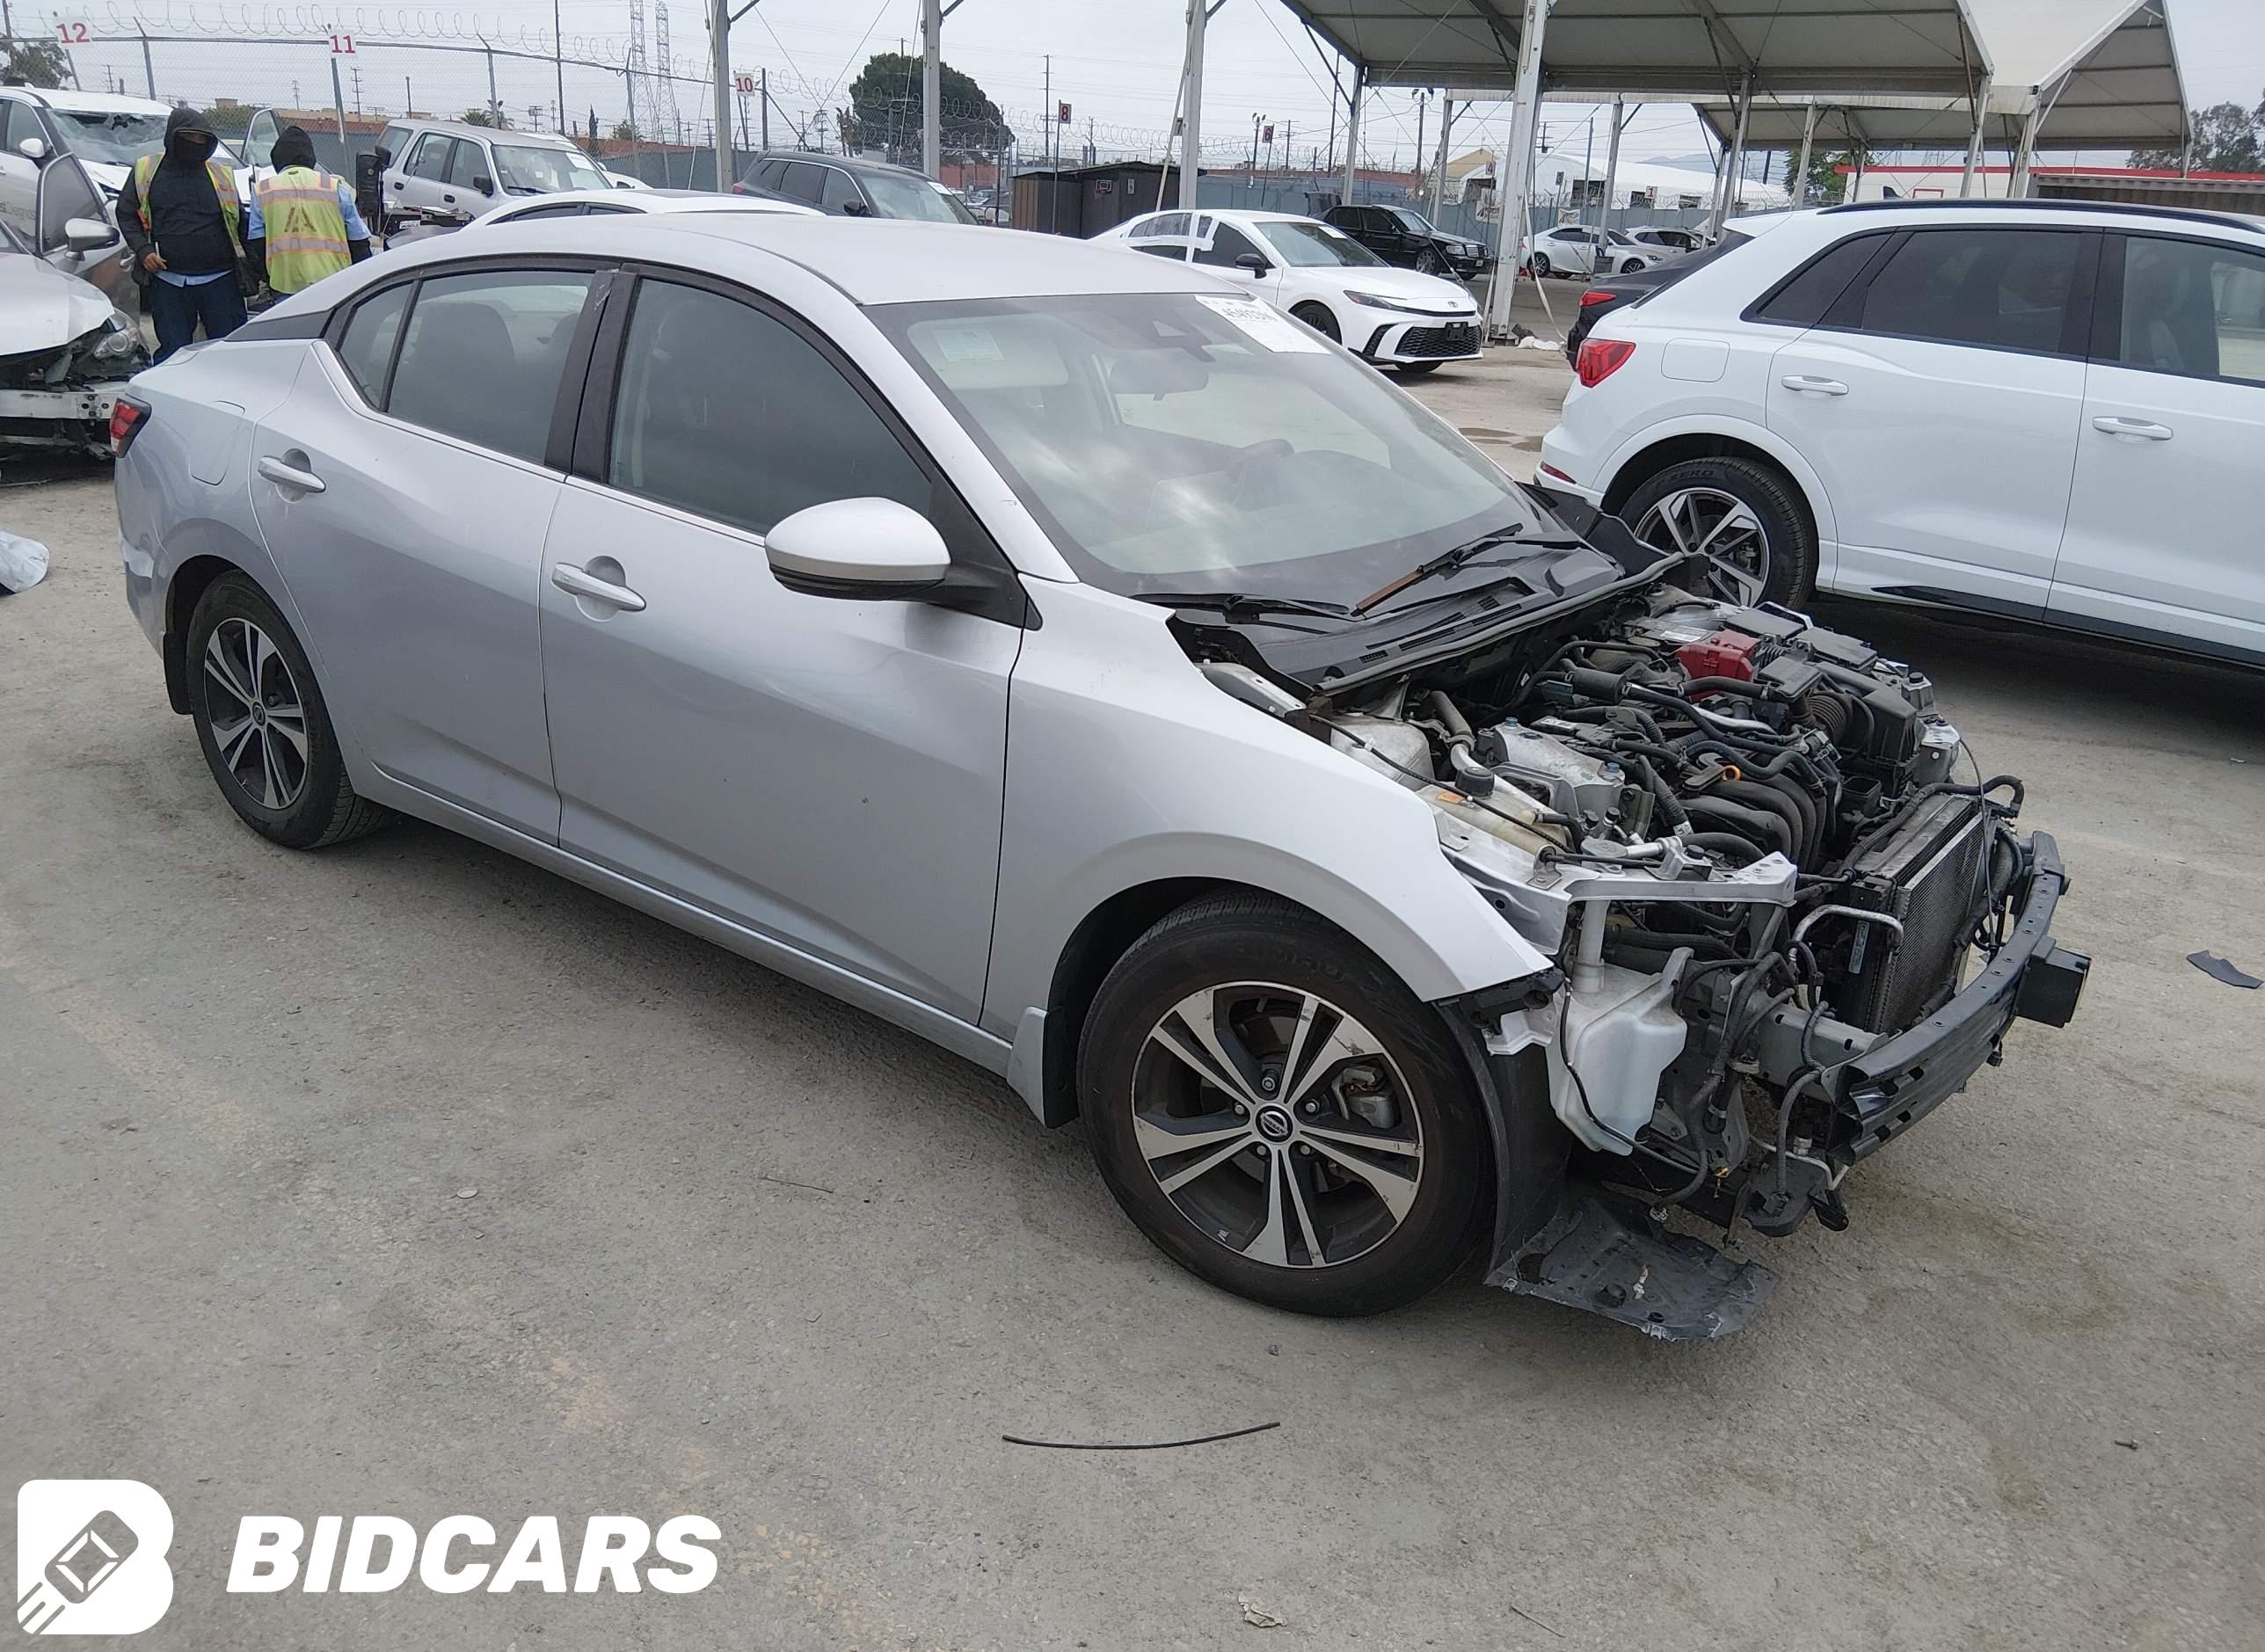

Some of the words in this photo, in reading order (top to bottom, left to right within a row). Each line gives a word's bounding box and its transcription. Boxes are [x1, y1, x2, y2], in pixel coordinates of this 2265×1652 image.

[56, 22, 91, 43] 12
[330, 34, 356, 54] 11
[735, 76, 754, 92] 10
[1060, 106, 1069, 121] 8
[1264, 127, 1271, 141] 6
[1647, 187, 1654, 197] 1
